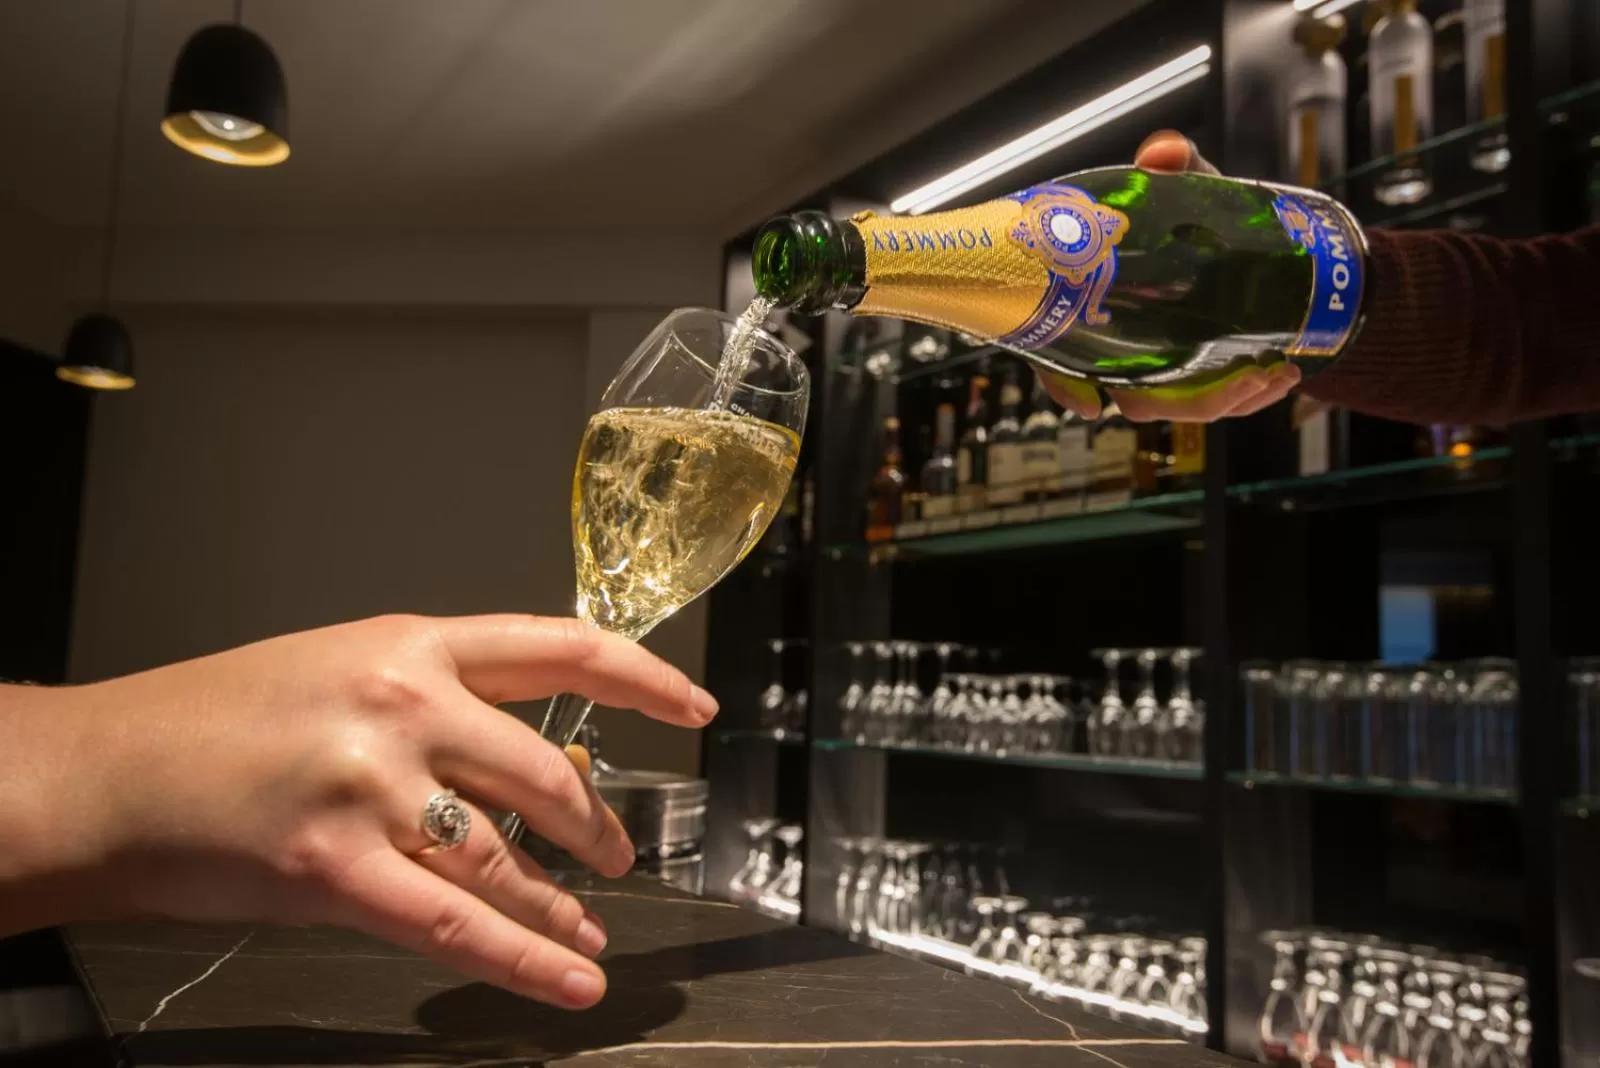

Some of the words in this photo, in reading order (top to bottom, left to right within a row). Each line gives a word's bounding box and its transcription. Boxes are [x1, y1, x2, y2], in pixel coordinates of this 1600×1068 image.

[871, 227, 993, 252] POMMERY
[1312, 204, 1350, 312] POMM
[1007, 294, 1072, 349] OMMERY
